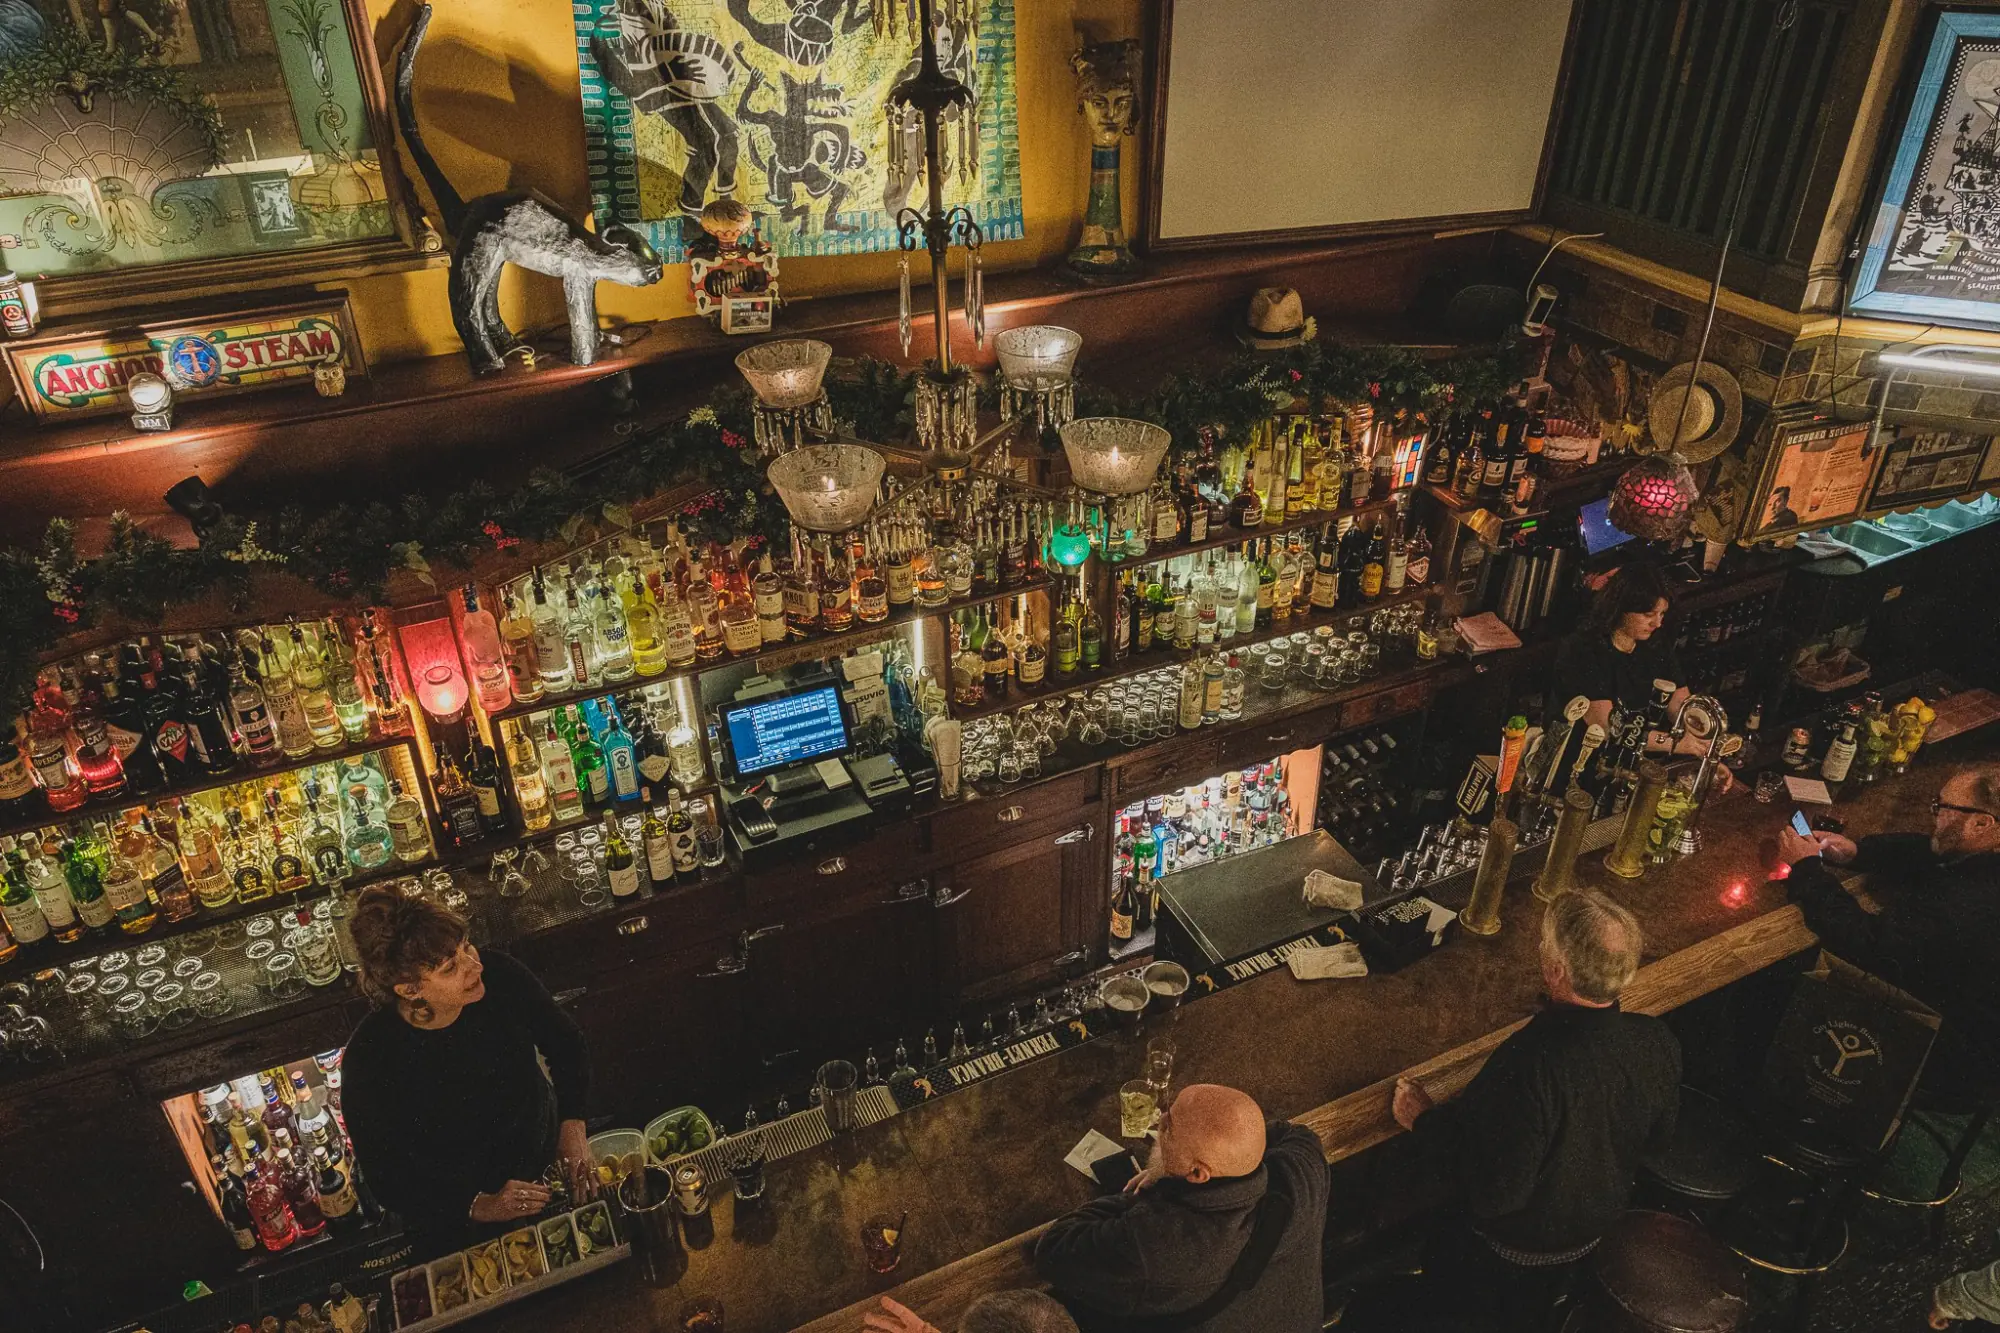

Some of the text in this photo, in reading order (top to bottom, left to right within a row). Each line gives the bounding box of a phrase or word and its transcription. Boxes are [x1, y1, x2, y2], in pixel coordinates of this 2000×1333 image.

[47, 330, 335, 396] ANCHOR STEAM
[138, 418, 162, 428] MM
[603, 624, 627, 636] ABSOLU
[1828, 1020, 1858, 1030] Lights
[948, 1032, 1061, 1086] FERNET-BRANCA
[362, 1245, 413, 1268] JAMESON
